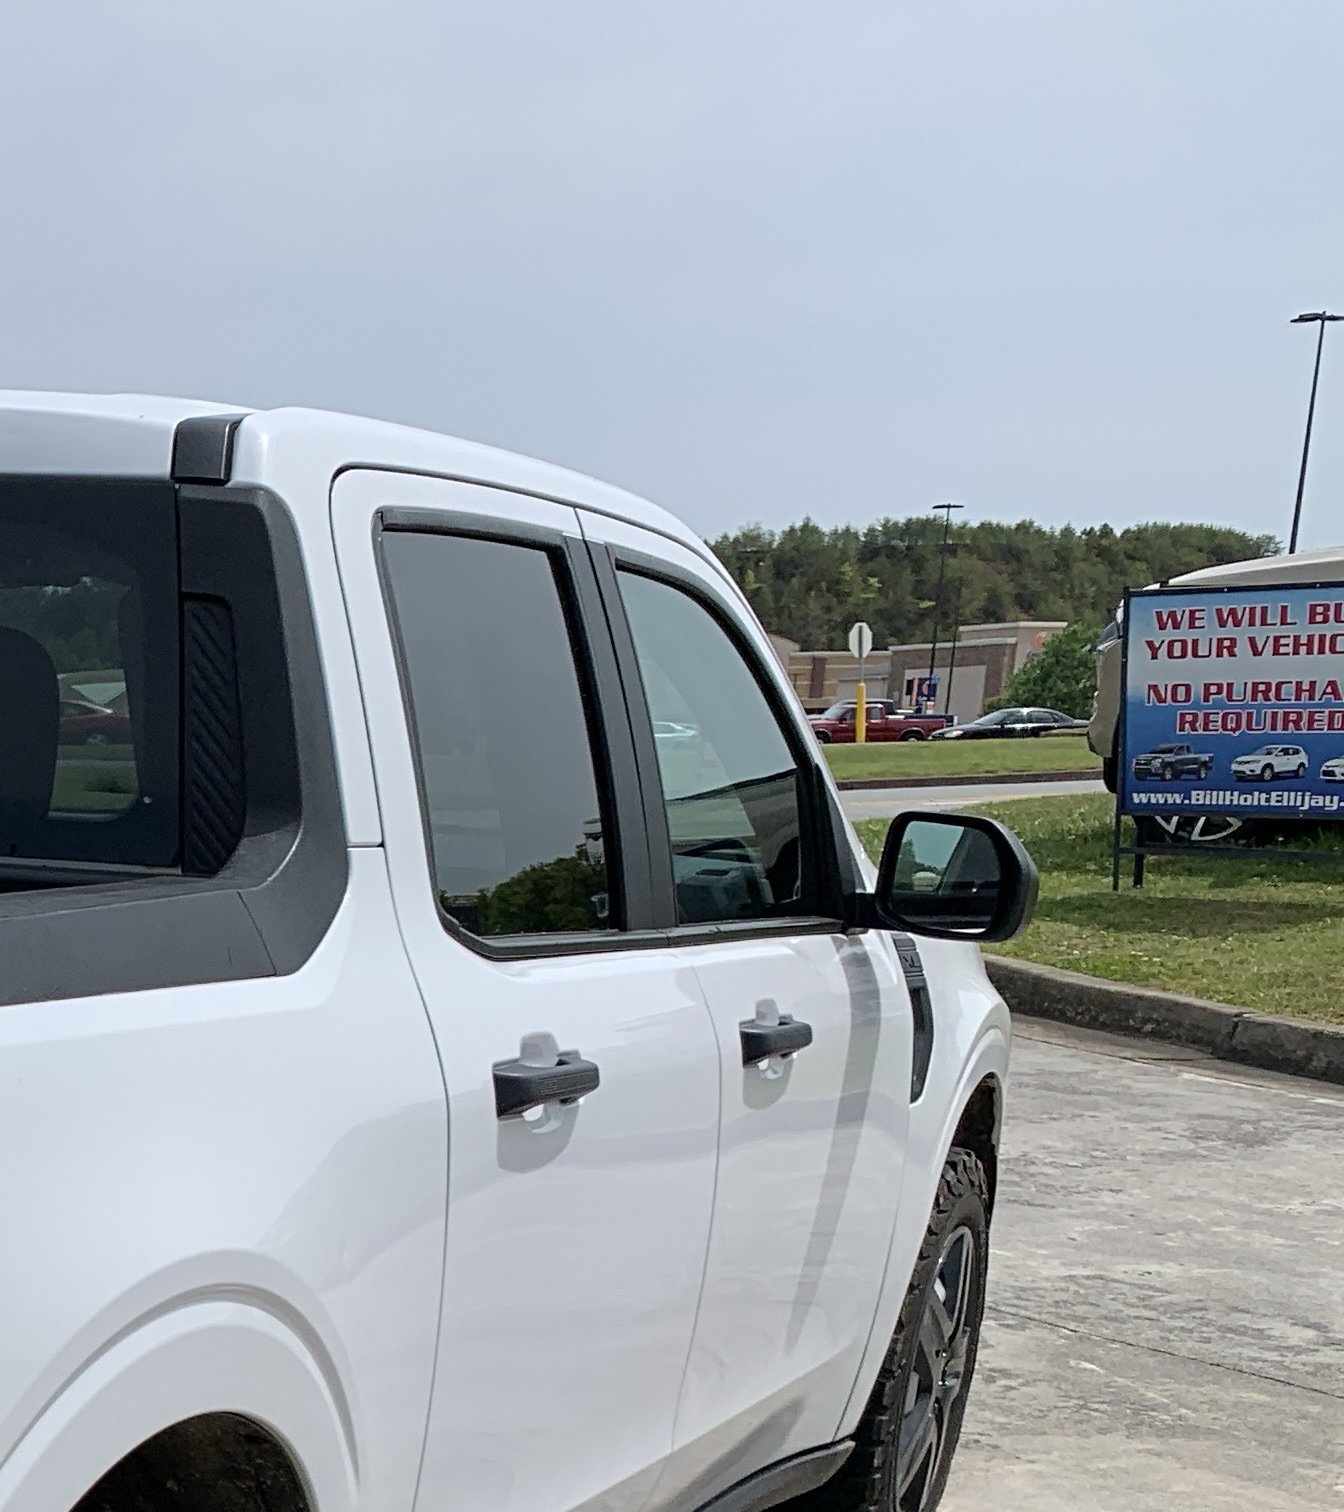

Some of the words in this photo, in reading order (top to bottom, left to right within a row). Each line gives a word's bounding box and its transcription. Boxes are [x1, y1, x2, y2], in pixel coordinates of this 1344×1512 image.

[1153, 607, 1206, 631] WE
[1215, 604, 1298, 629] WILL
[1144, 636, 1238, 661] YOUR
[1145, 682, 1193, 706] NO
[1202, 679, 1344, 705] PURCHA
[1176, 707, 1344, 736] REQUIRED
